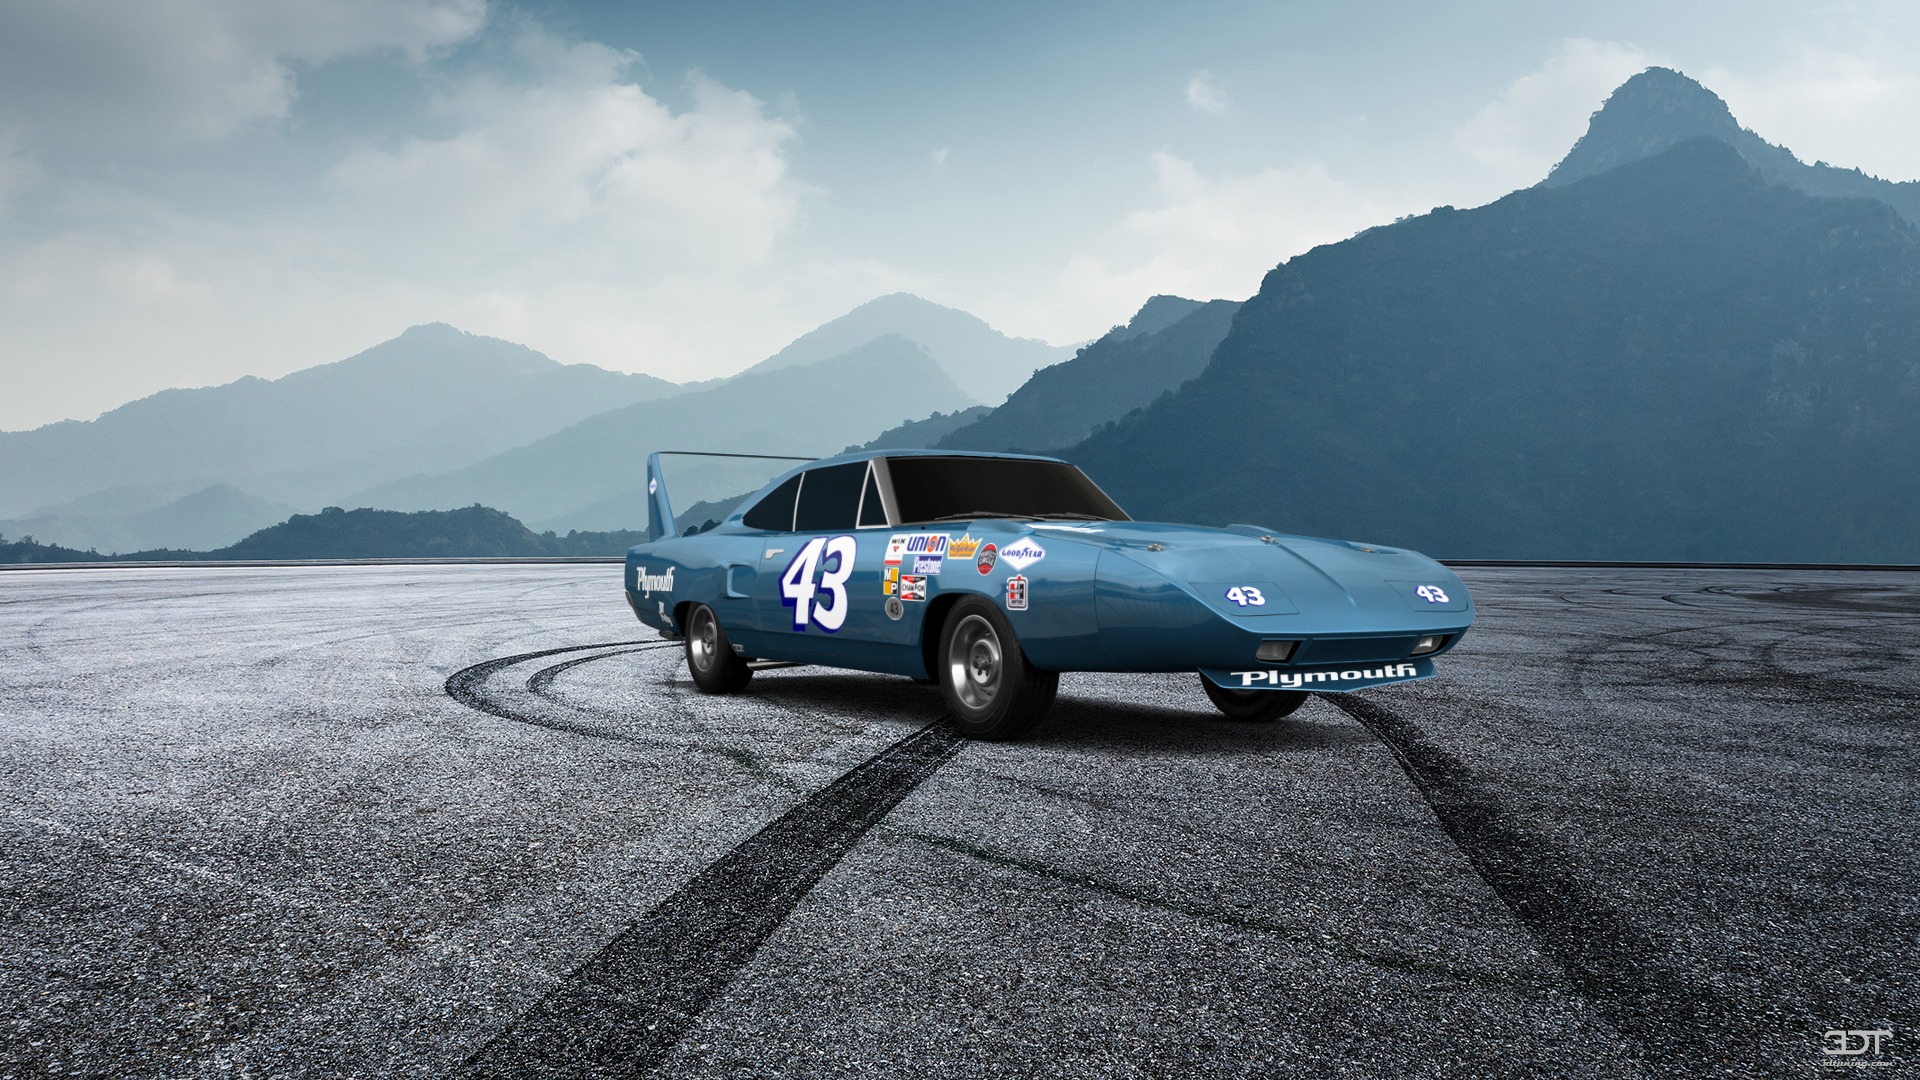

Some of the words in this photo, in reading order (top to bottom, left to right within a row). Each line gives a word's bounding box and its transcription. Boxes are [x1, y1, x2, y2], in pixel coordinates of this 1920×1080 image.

[636, 566, 676, 599] Plymouth
[778, 535, 857, 634] 43
[1415, 585, 1450, 603] 43
[1225, 586, 1266, 607] 43
[1230, 663, 1417, 688] Plymouth
